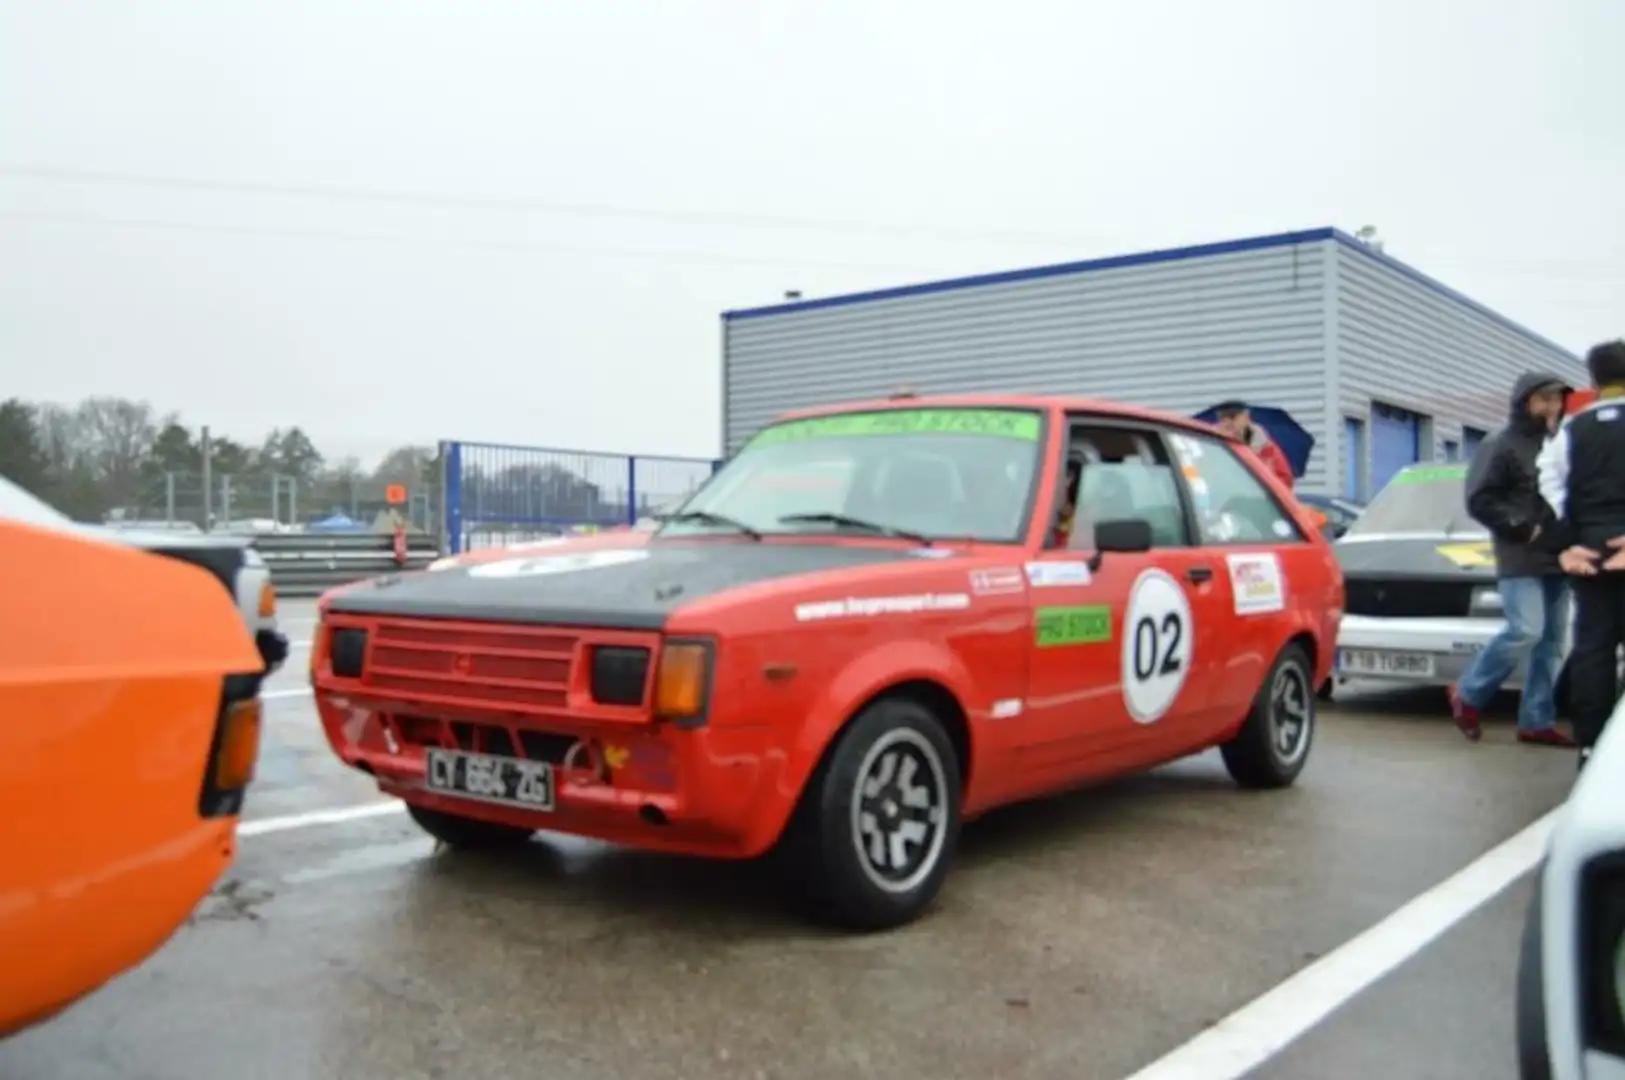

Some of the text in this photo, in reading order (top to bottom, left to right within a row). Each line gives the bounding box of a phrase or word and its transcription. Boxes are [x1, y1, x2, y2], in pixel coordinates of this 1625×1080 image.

[924, 409, 1016, 433] STOCK
[1134, 611, 1182, 682] 02
[1379, 653, 1431, 674] TURBO
